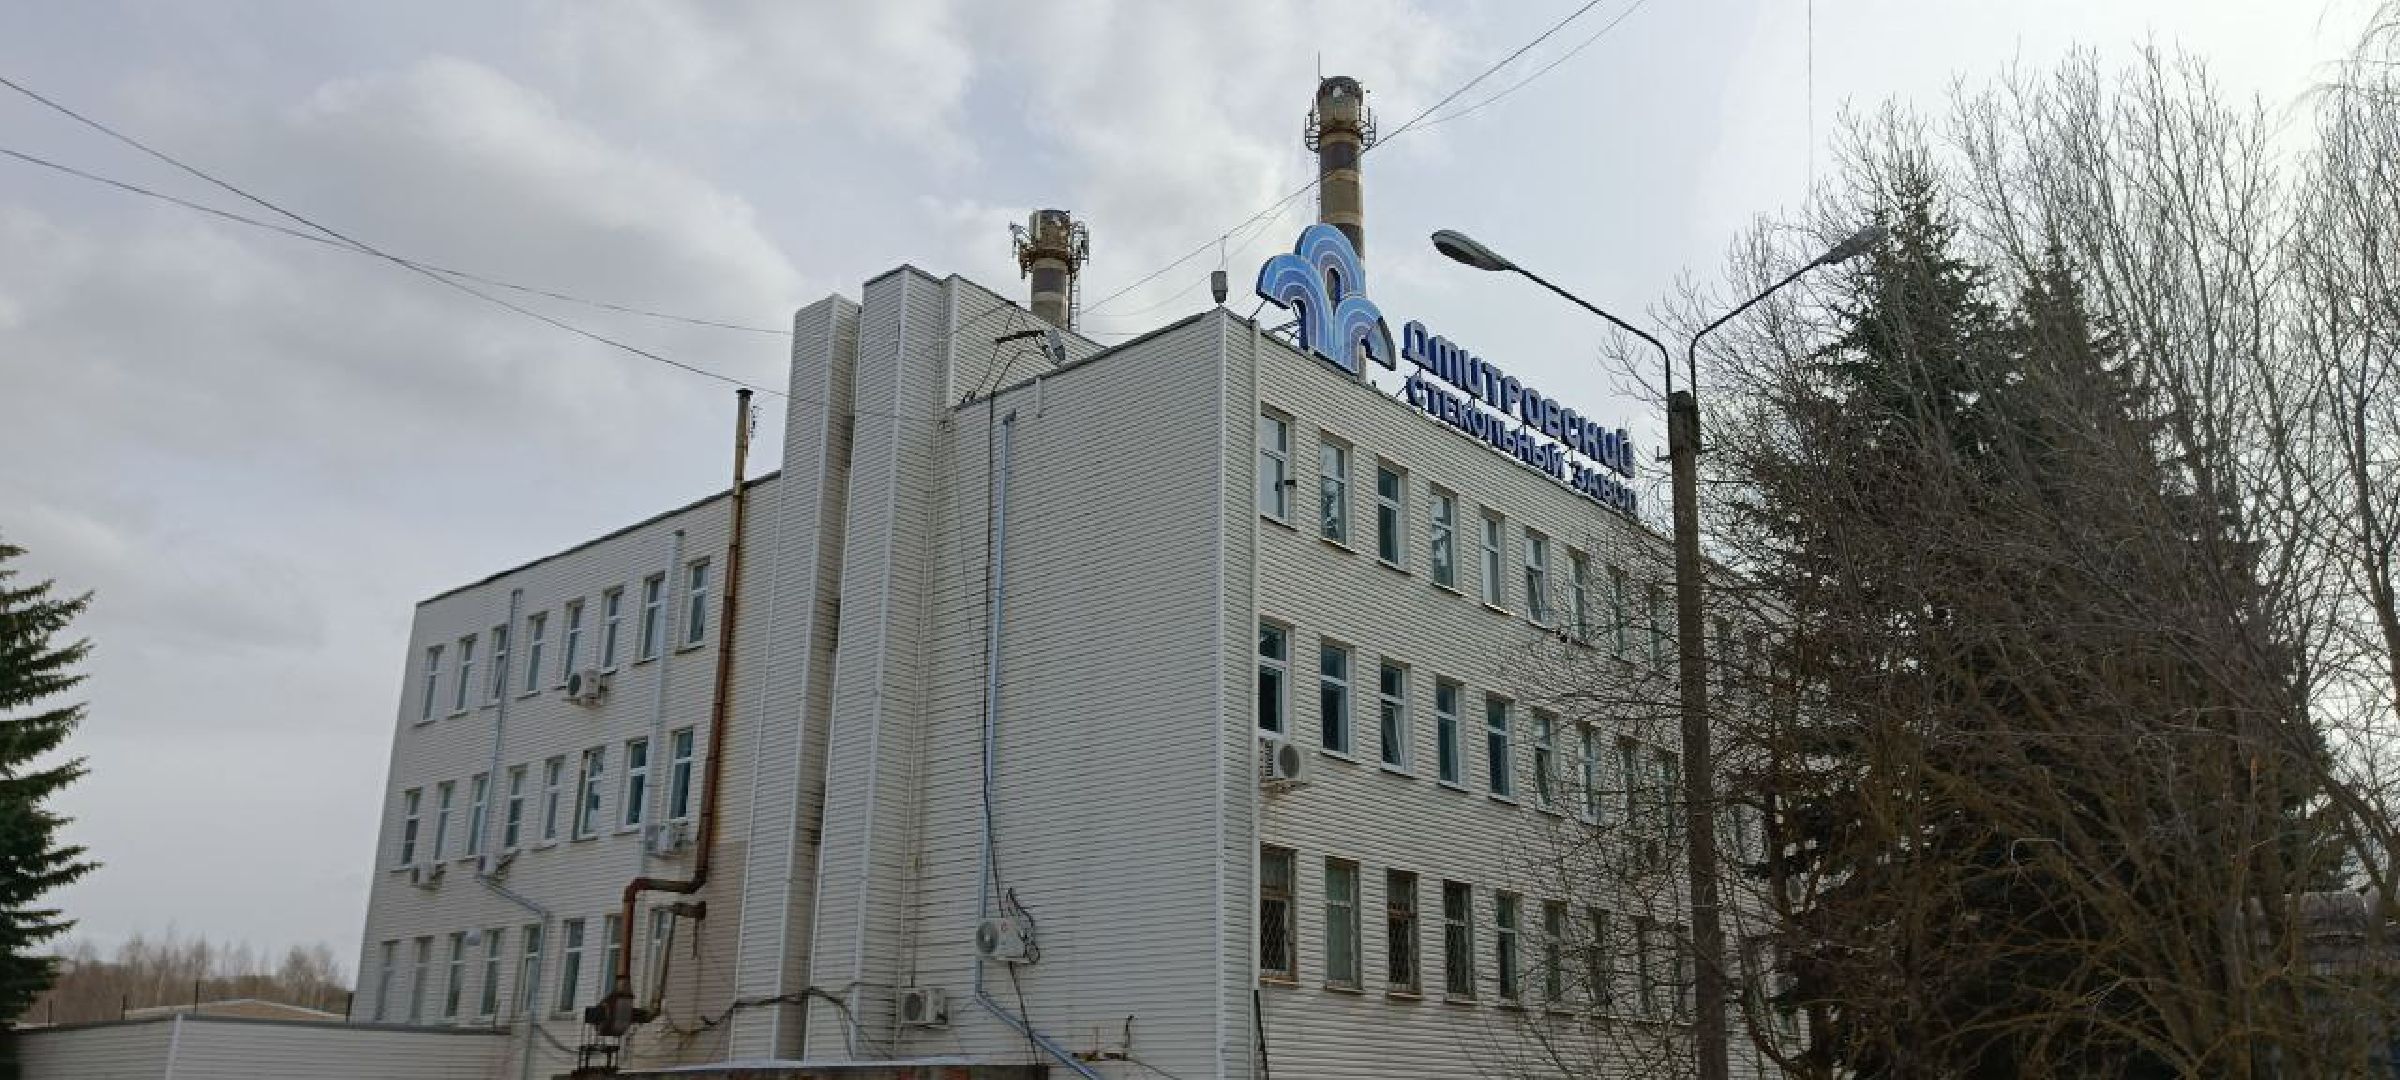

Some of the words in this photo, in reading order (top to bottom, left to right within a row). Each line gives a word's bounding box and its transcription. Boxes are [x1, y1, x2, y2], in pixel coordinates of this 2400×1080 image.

[1402, 320, 1635, 478] ДМИТРОВСКИЙ
[1406, 376, 1565, 481] СТЕКОЛЬНЫЙ
[1571, 461, 1637, 517] ЗАВОД
